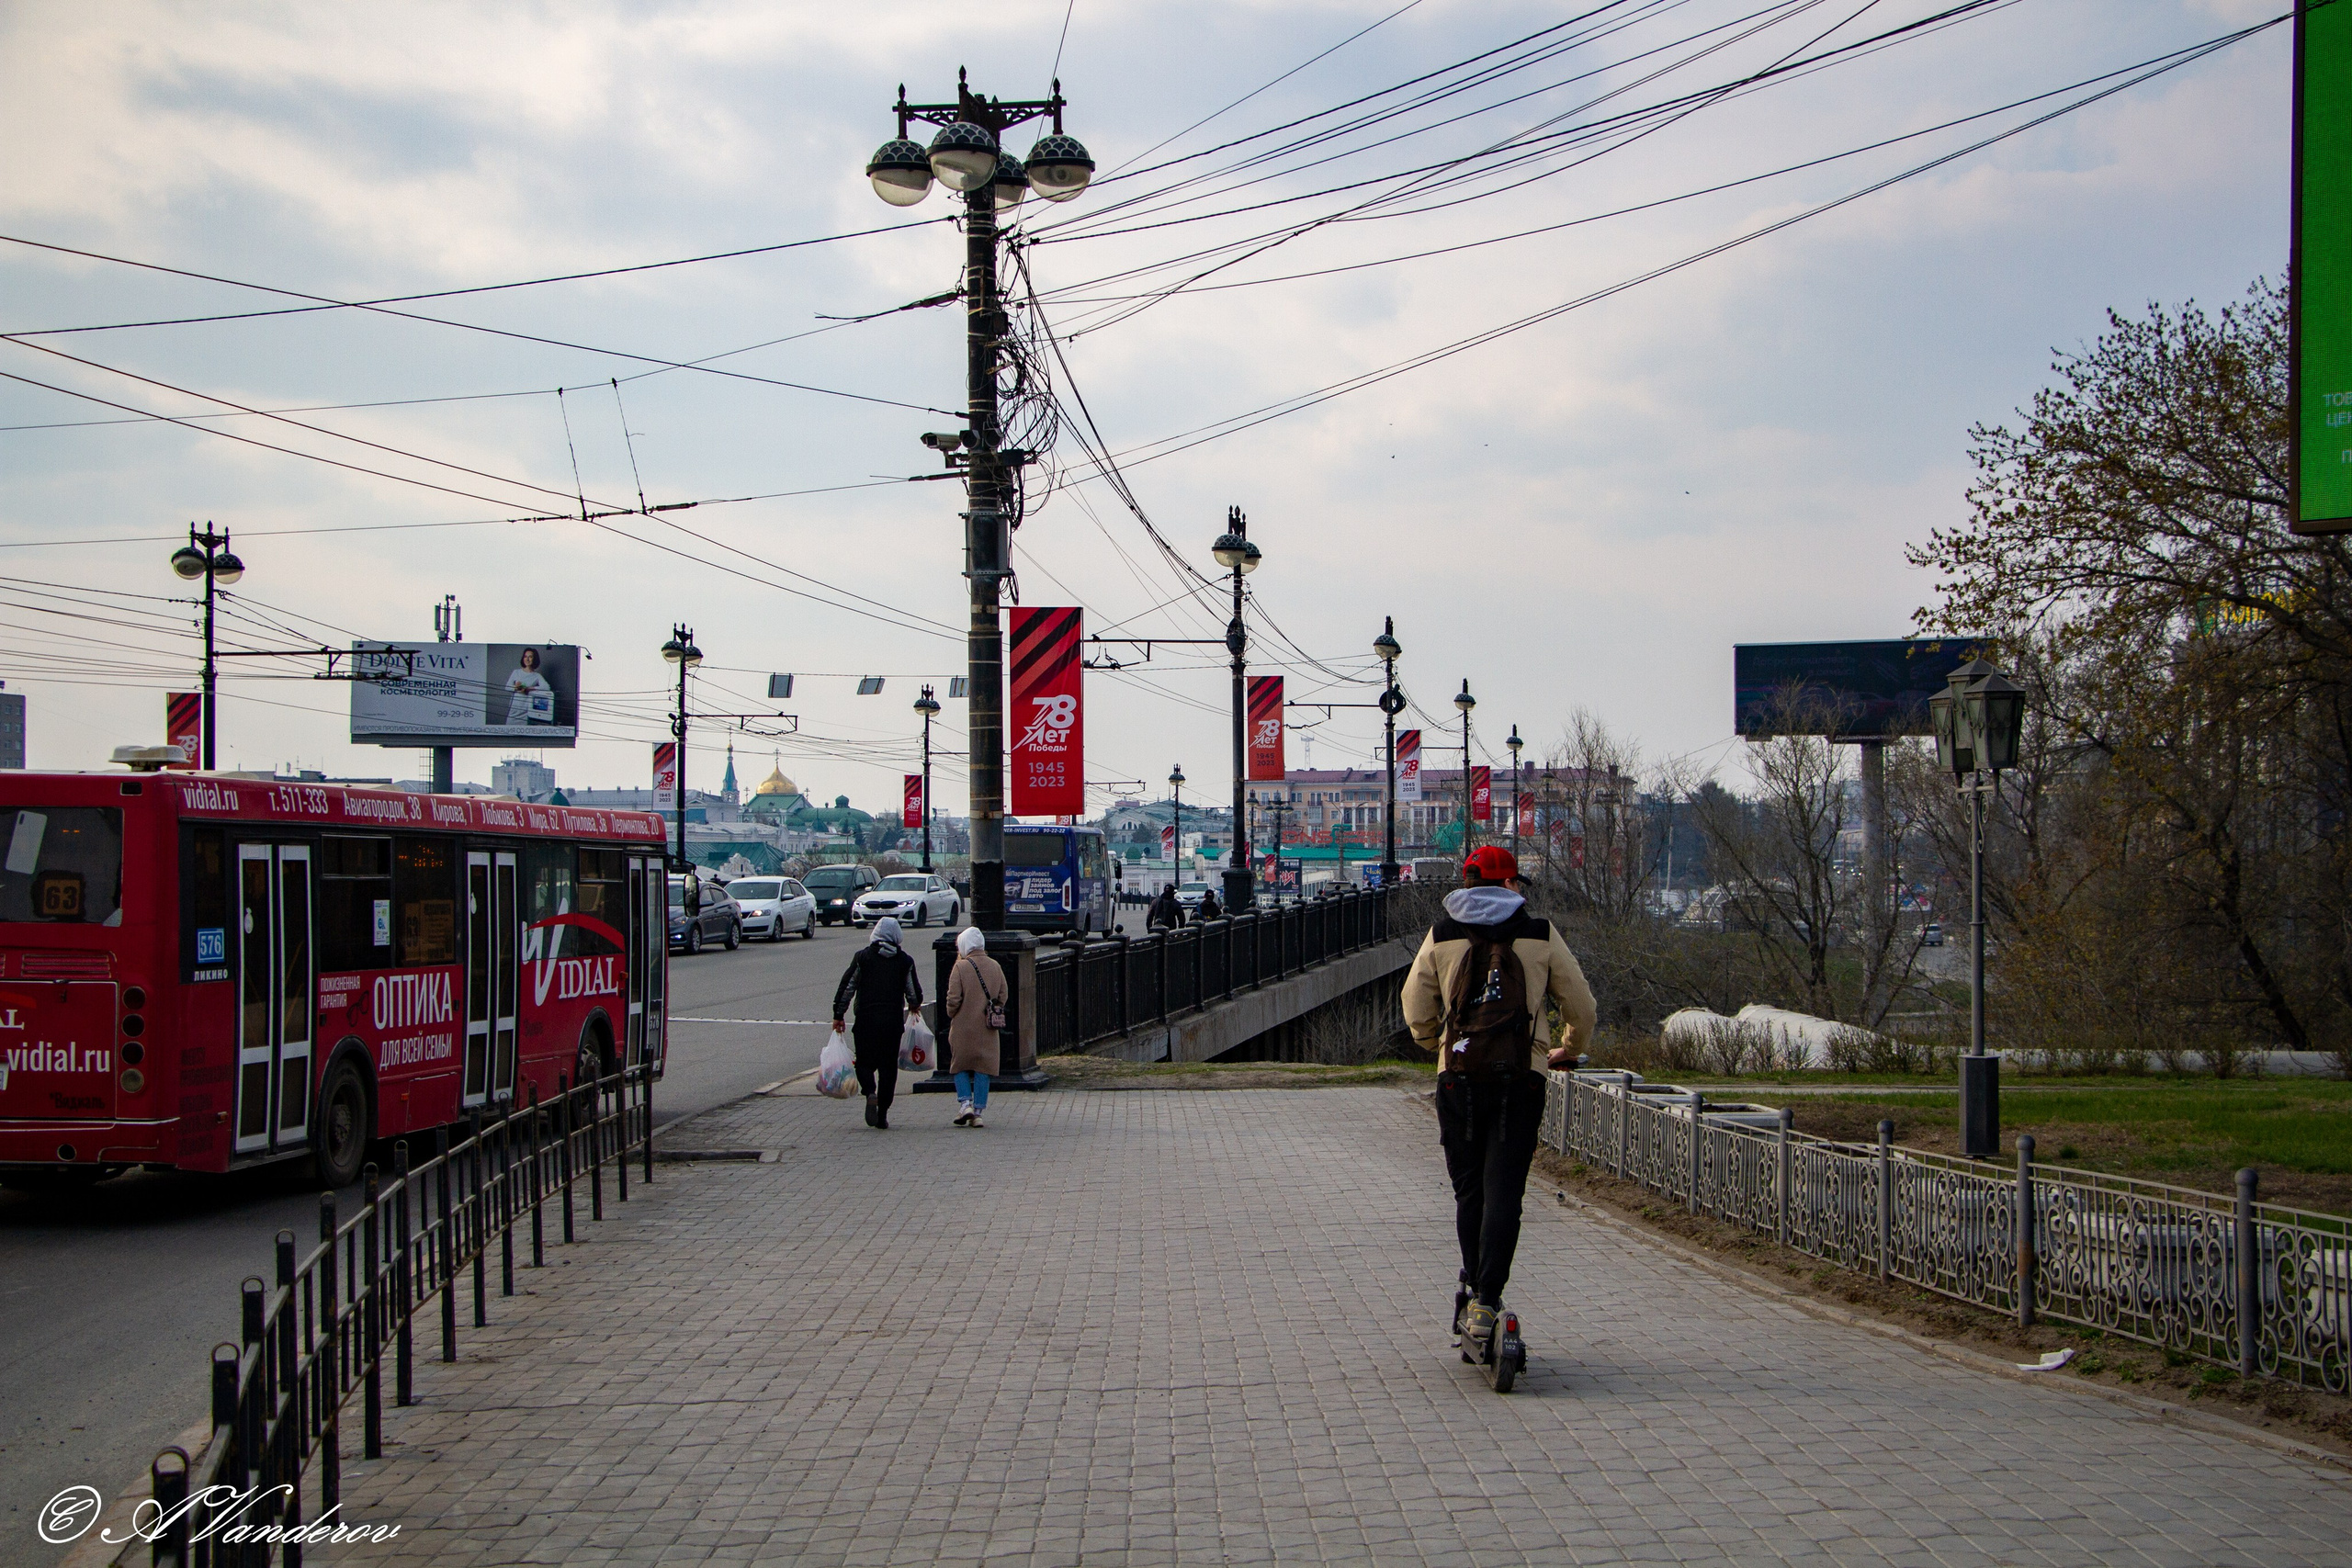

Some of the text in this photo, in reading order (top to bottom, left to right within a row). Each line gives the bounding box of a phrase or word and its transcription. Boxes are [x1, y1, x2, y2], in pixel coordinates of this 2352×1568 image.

[380, 680, 457, 688] СОВРЕМЕННАЯ
[380, 688, 457, 696] КОСМЕТОЛОГИЯ
[437, 710, 474, 718] 99-29-85
[1031, 694, 1077, 728] 78
[1258, 719, 1281, 737] 78
[176, 735, 198, 752] 78
[1029, 743, 1067, 751] Победы
[1029, 762, 1065, 773] 1945
[1404, 760, 1419, 771] 78
[661, 772, 674, 783] 78
[1029, 776, 1066, 787] 2023
[183, 782, 239, 810] vidial.ru
[279, 786, 329, 814] 511-333
[910, 796, 922, 806] 78
[1476, 788, 1489, 797] 78
[343, 791, 422, 823] Авиагородок, 38
[430, 798, 473, 826] Кирова, 7
[481, 803, 524, 829] Лобкова, 3
[527, 807, 560, 834] Мира, 62
[562, 810, 598, 834] Путилова,
[649, 817, 659, 836] 20
[1059, 815, 1069, 823] 78
[1282, 830, 1332, 843] DNS
[45, 886, 79, 910] 63
[199, 934, 221, 955] 576
[522, 897, 619, 1007] VIDIAL
[321, 976, 360, 992] ПОЖИЗНЕННАЯ
[321, 993, 347, 1009] ГАРАНТИЯ
[374, 972, 453, 1030] ОПТИКА
[7, 1041, 111, 1072] vidial.ru
[379, 1030, 453, 1072] ДЛЯ ВСЕЙ СЕМЬИ
